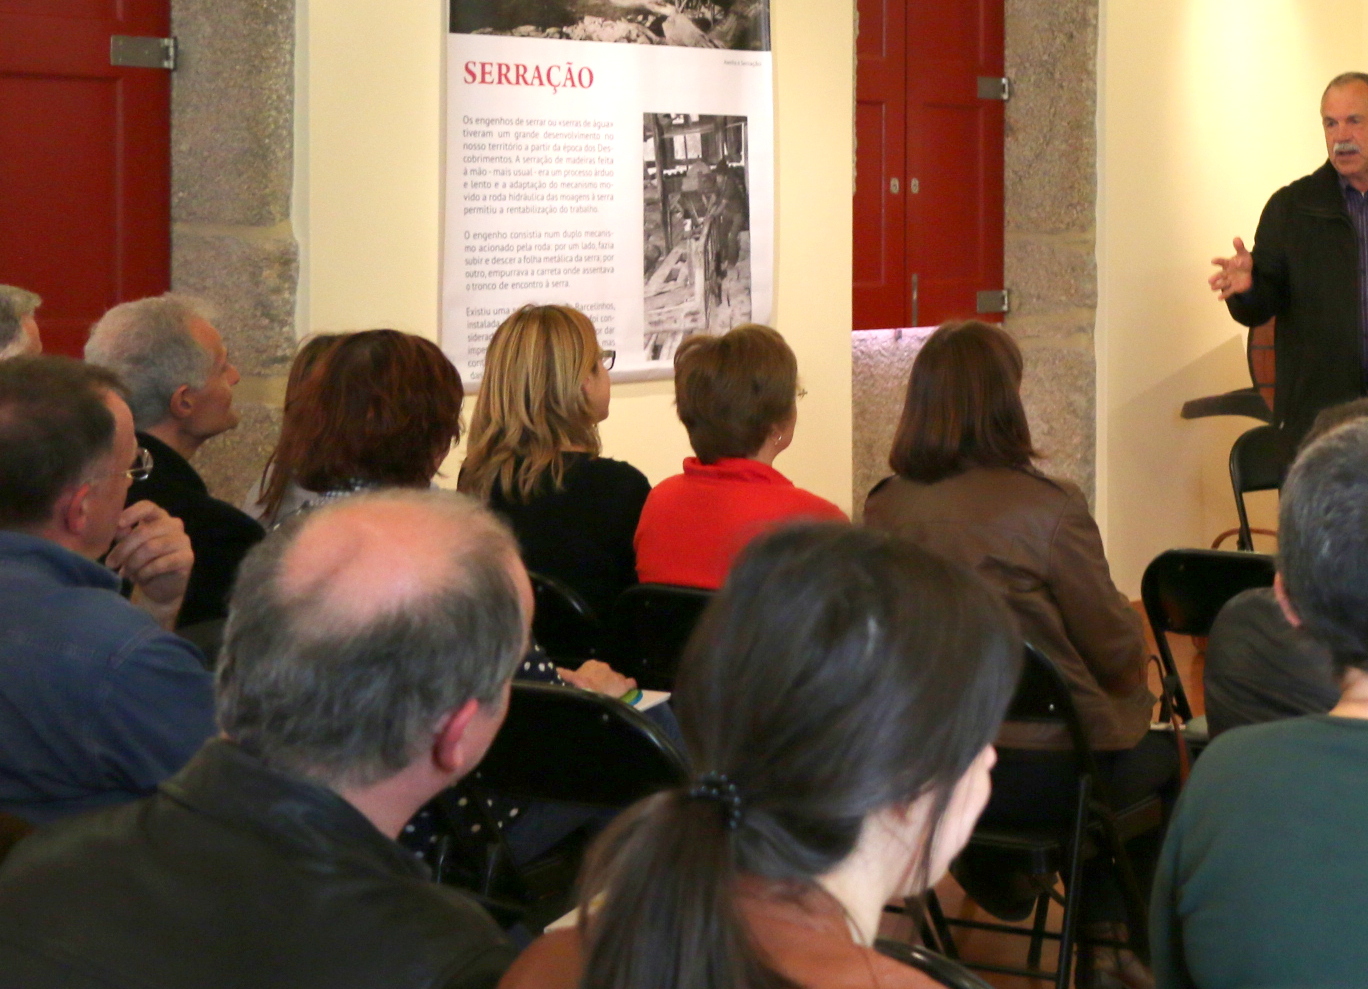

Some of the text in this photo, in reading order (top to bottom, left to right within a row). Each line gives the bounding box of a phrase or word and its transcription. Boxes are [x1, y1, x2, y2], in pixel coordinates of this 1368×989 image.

[464, 61, 594, 95] SERRAÇÃO
[463, 116, 473, 125] Os
[475, 117, 513, 127] engenhos
[463, 129, 493, 137] tiveram
[514, 131, 539, 140] grande
[543, 131, 600, 139] desenvolvimento
[488, 142, 522, 151] território
[531, 143, 550, 153] partir
[553, 143, 561, 151] da
[563, 144, 583, 153] época
[523, 156, 552, 165] serração
[566, 156, 596, 164] madeiras
[598, 156, 614, 164] feita
[493, 168, 511, 176] mais
[513, 168, 533, 176] usual
[564, 170, 592, 178] processo
[509, 181, 547, 190] adaptação
[463, 193, 480, 201] vido
[489, 193, 507, 201] roda
[508, 193, 544, 201] hidráulica
[546, 193, 558, 201] das
[560, 194, 590, 203] moagens
[463, 205, 497, 216] permitiu
[507, 205, 557, 215] rentabilização
[464, 231, 470, 239] O
[473, 231, 507, 241] engenho
[510, 231, 542, 239] consistia
[563, 230, 582, 239] duplo
[479, 243, 514, 252] acionado
[517, 243, 532, 253] pela
[555, 244, 566, 252] por
[465, 257, 483, 265] subir
[491, 256, 516, 265] descer
[524, 255, 542, 264] folha
[543, 254, 573, 263] metálica
[575, 254, 583, 262] da
[603, 254, 614, 262] por
[465, 269, 487, 279] outro,
[488, 269, 529, 279] empurrava
[537, 268, 561, 276] carreta
[563, 266, 580, 274] onde
[582, 266, 614, 274] assentava
[466, 283, 470, 291] o
[472, 282, 496, 290] tronco
[499, 281, 508, 289] de
[511, 280, 543, 289] encontro
[466, 307, 491, 317] Existiu
[493, 307, 510, 315] uma
[467, 319, 500, 329] instalada
[605, 326, 614, 334] dar
[602, 339, 615, 347] mas
